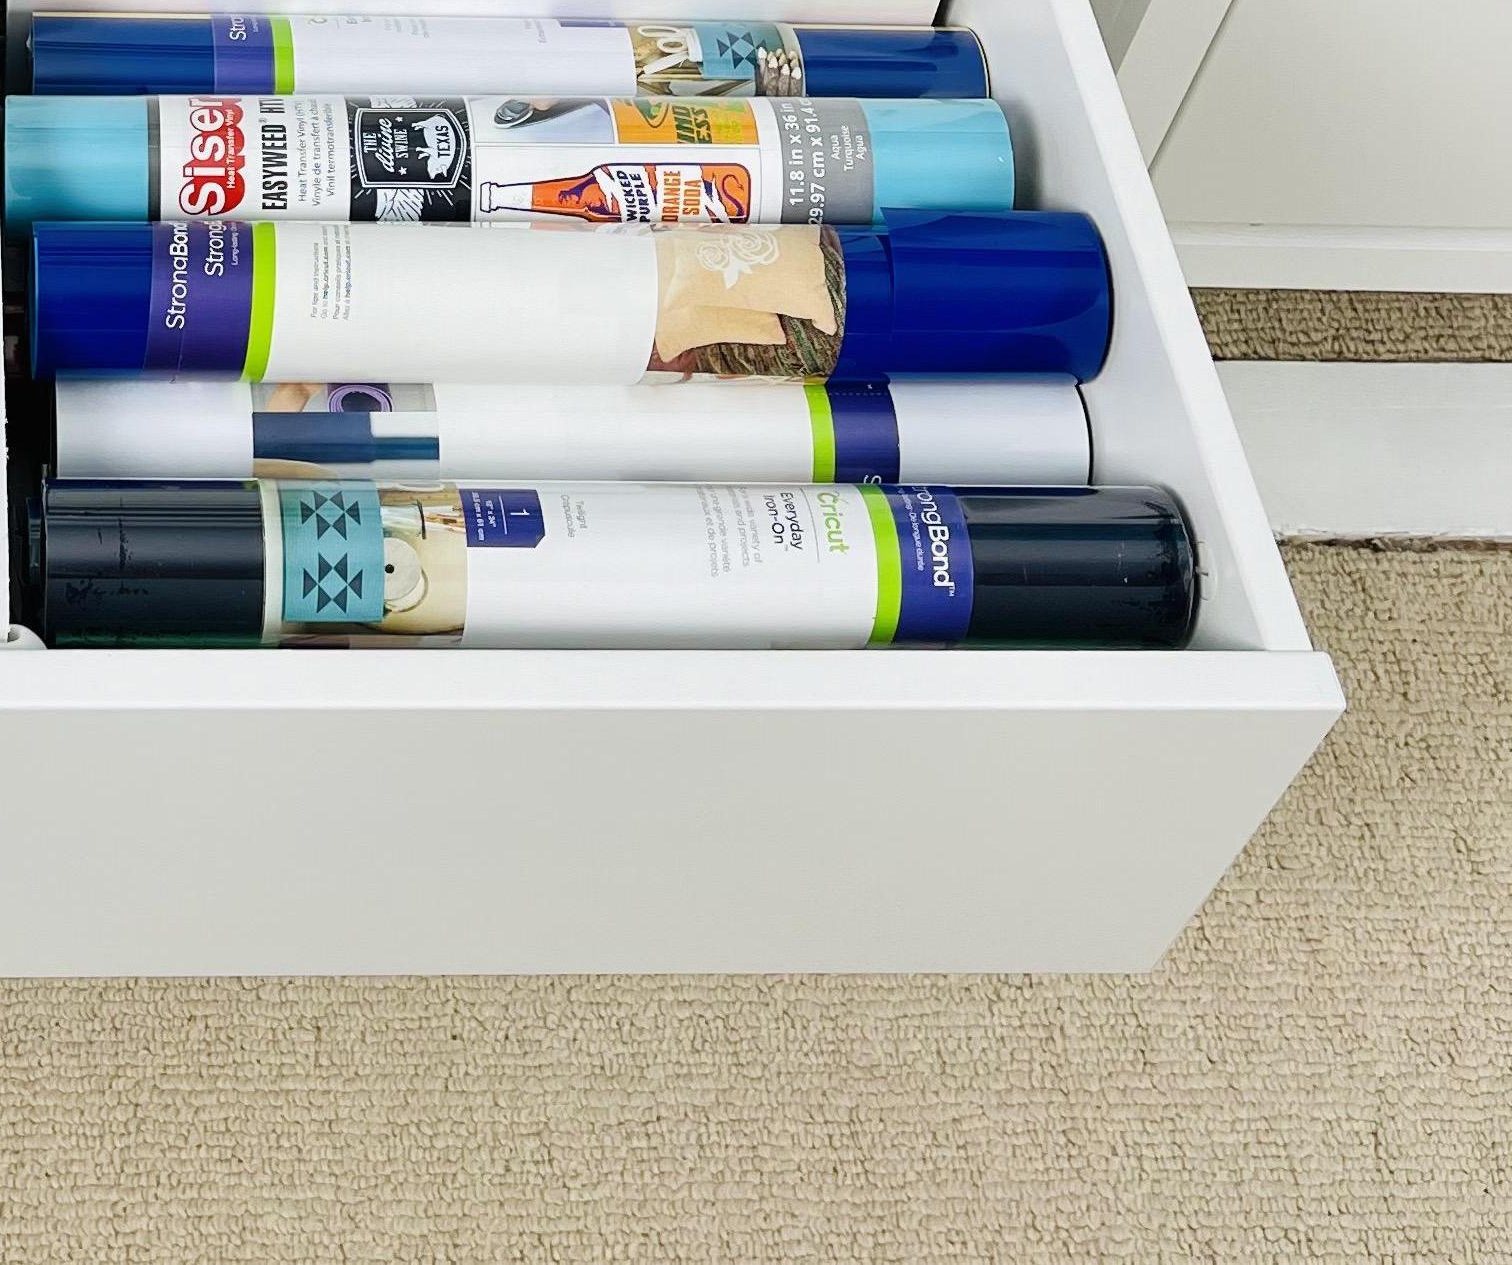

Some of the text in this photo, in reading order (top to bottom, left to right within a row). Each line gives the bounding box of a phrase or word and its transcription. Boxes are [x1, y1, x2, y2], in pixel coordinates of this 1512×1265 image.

[784, 115, 801, 132] 36
[802, 106, 821, 133] 91.4
[180, 98, 226, 215] Siser
[226, 127, 236, 164] Transfer
[362, 132, 378, 153] THE
[375, 117, 395, 173] divine
[393, 128, 409, 159] SWINE
[435, 125, 451, 159] TEXAS
[789, 148, 803, 166] in
[790, 136, 802, 145] x
[809, 136, 823, 145] x
[830, 134, 841, 160] Aqua
[841, 124, 855, 172] Turquoise
[855, 134, 870, 160] Agua
[297, 142, 307, 180] Transfer
[311, 124, 322, 207] Vinyle de transfert
[811, 150, 824, 179] cm
[226, 169, 236, 189] Heat
[297, 181, 307, 202] Heat
[616, 170, 638, 222] WICKED
[789, 170, 805, 207] 11.8
[628, 172, 651, 223] PURPLE
[661, 170, 682, 223] ORANGE
[682, 179, 702, 216] SODA
[509, 508, 531, 516] 1
[780, 492, 804, 551] Everyday
[816, 491, 851, 556] Cricut
